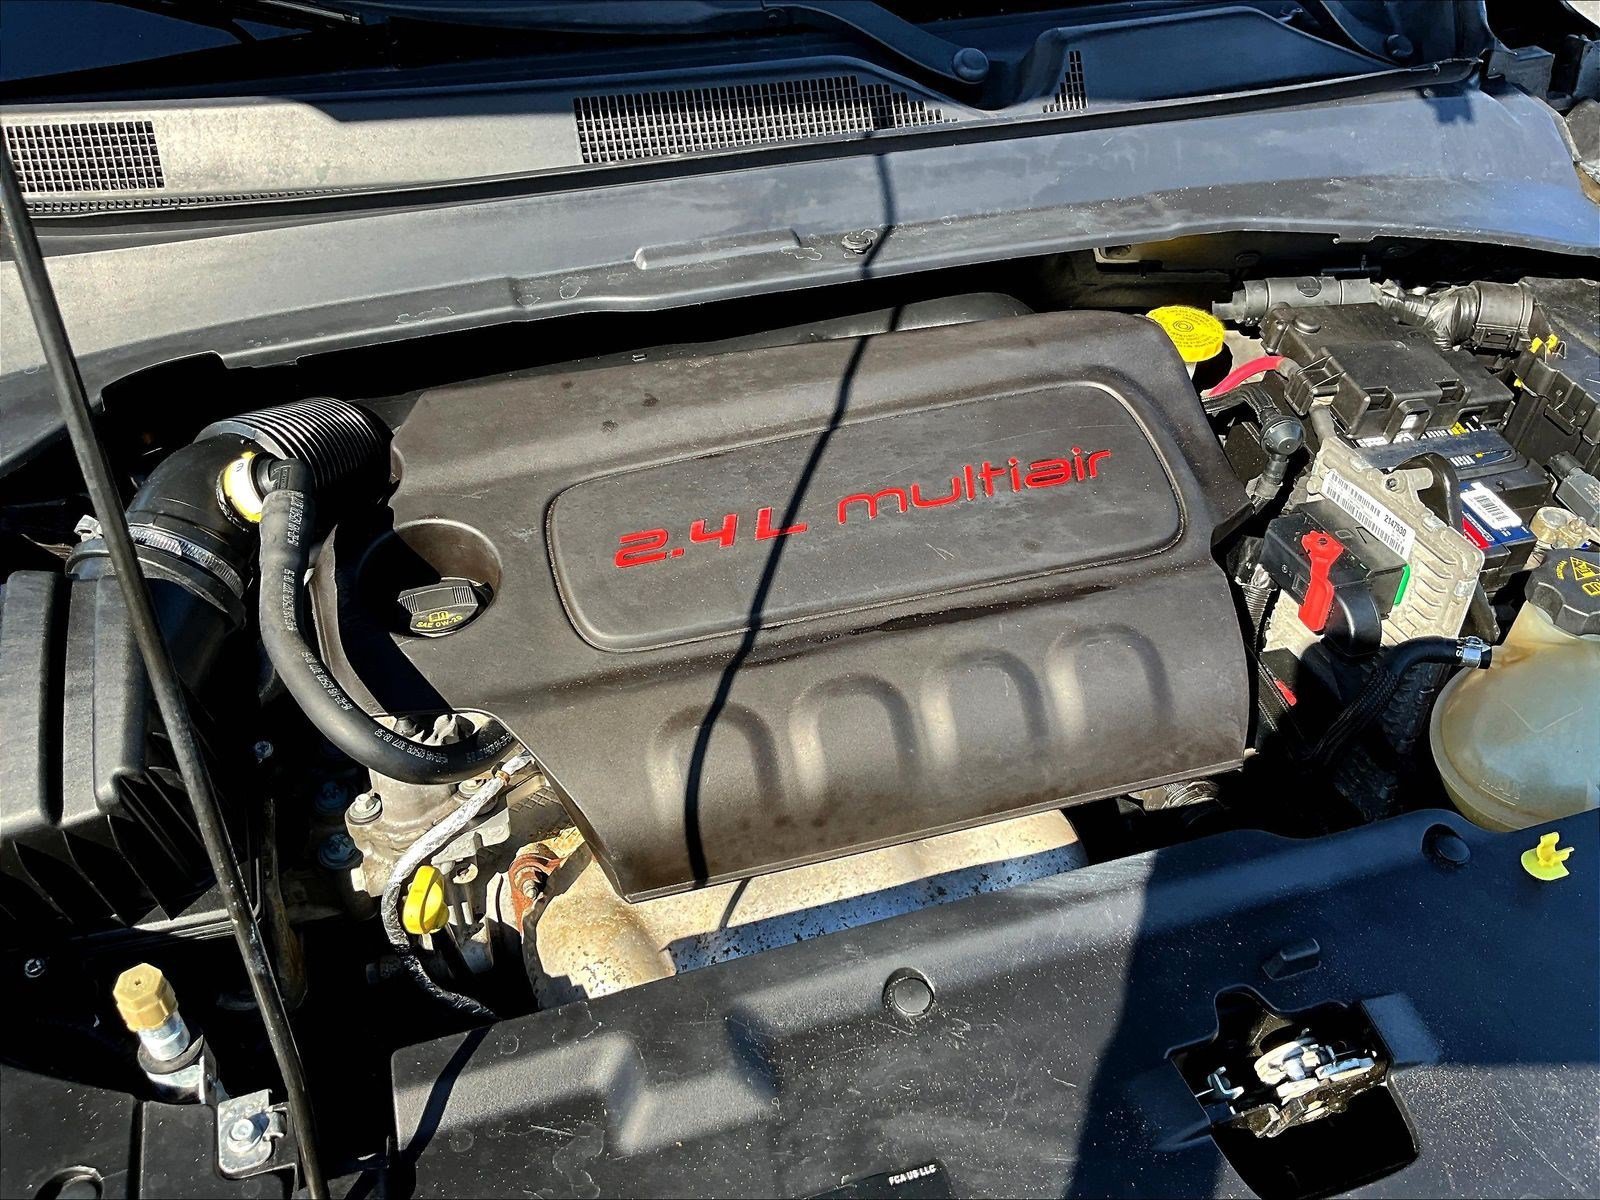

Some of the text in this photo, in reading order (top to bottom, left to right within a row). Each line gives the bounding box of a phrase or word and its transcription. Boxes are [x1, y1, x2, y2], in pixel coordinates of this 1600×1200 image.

[837, 447, 1111, 524] multiair
[435, 615, 463, 627] 0W-20
[888, 1164, 937, 1186] FCA US LLC
